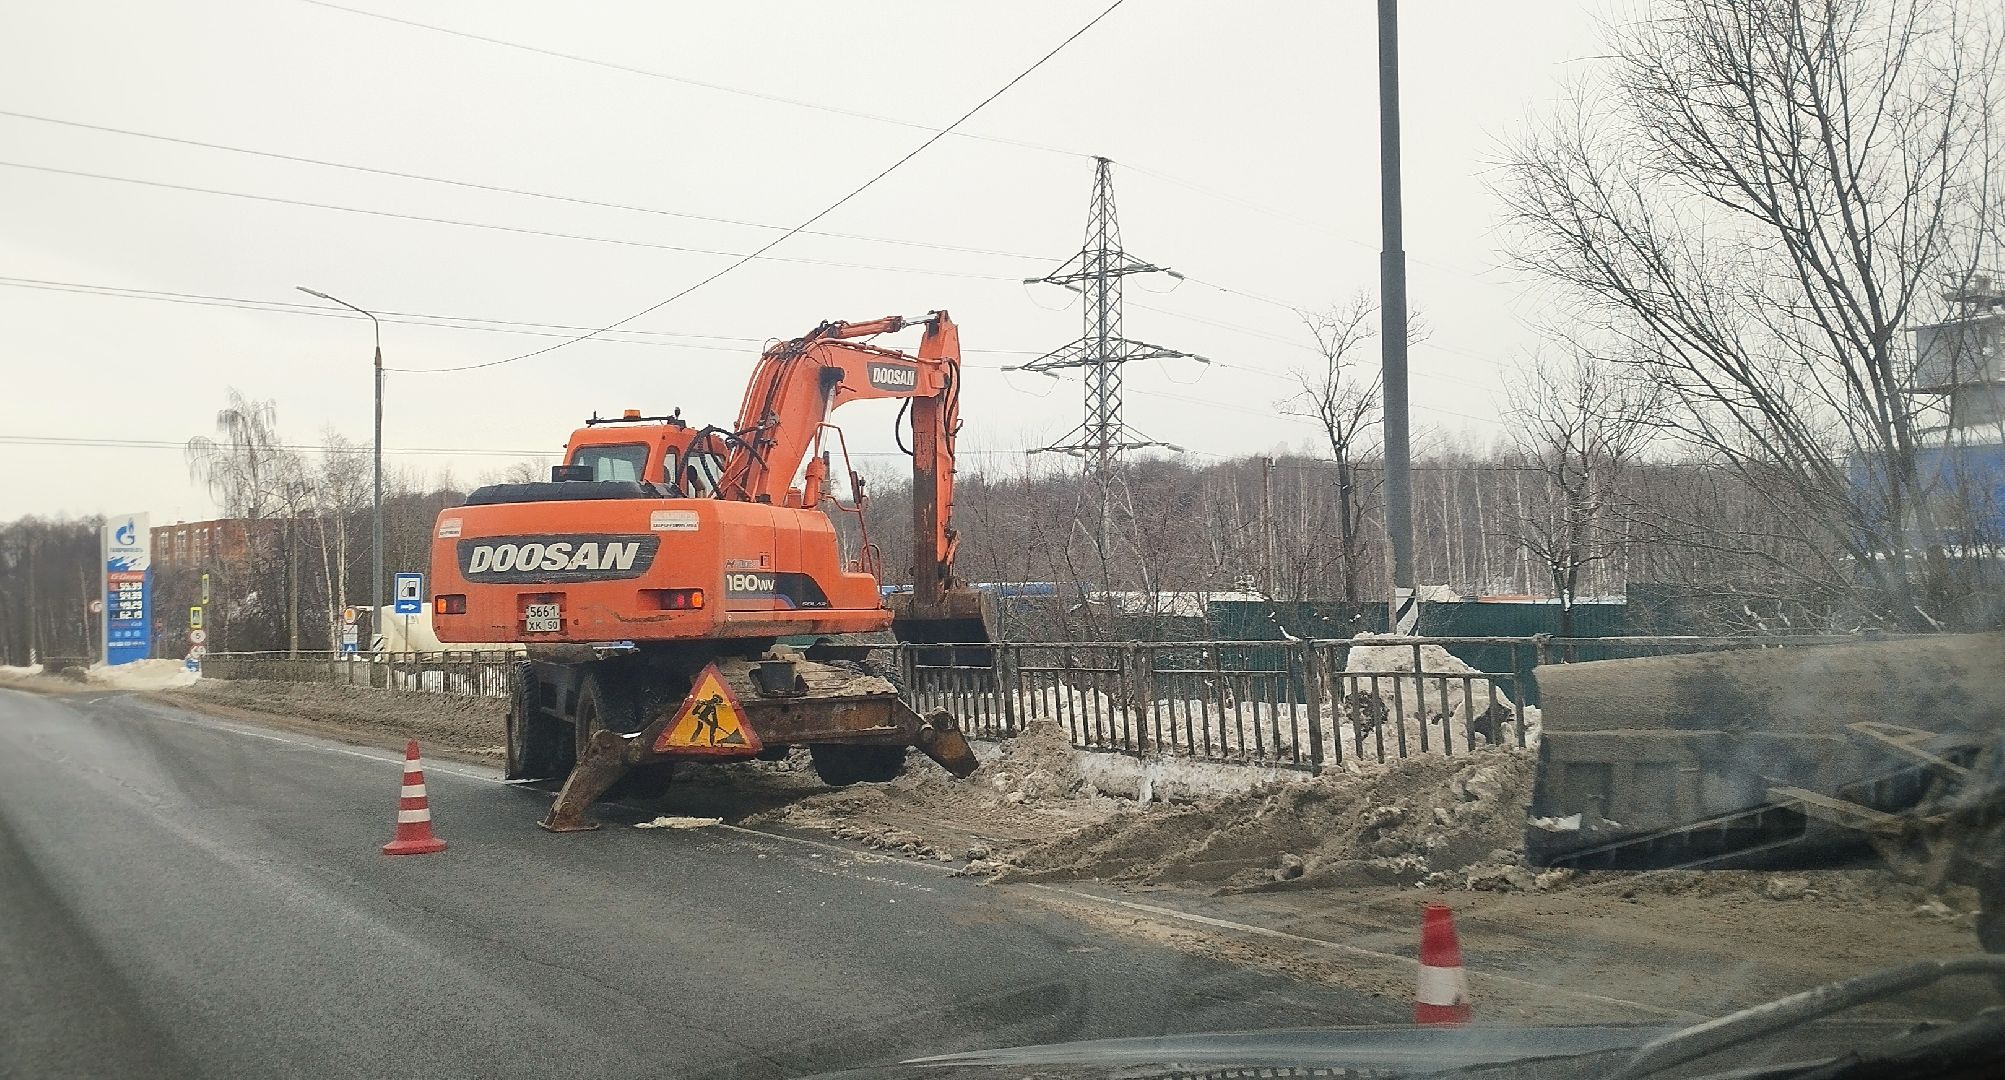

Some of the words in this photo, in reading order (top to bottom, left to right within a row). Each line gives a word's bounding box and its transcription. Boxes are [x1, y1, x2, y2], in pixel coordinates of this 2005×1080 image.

[873, 368, 914, 385] DOOSAN
[468, 542, 640, 573] DOOSAN
[530, 605, 556, 618] 5661
[547, 620, 558, 630] 50
